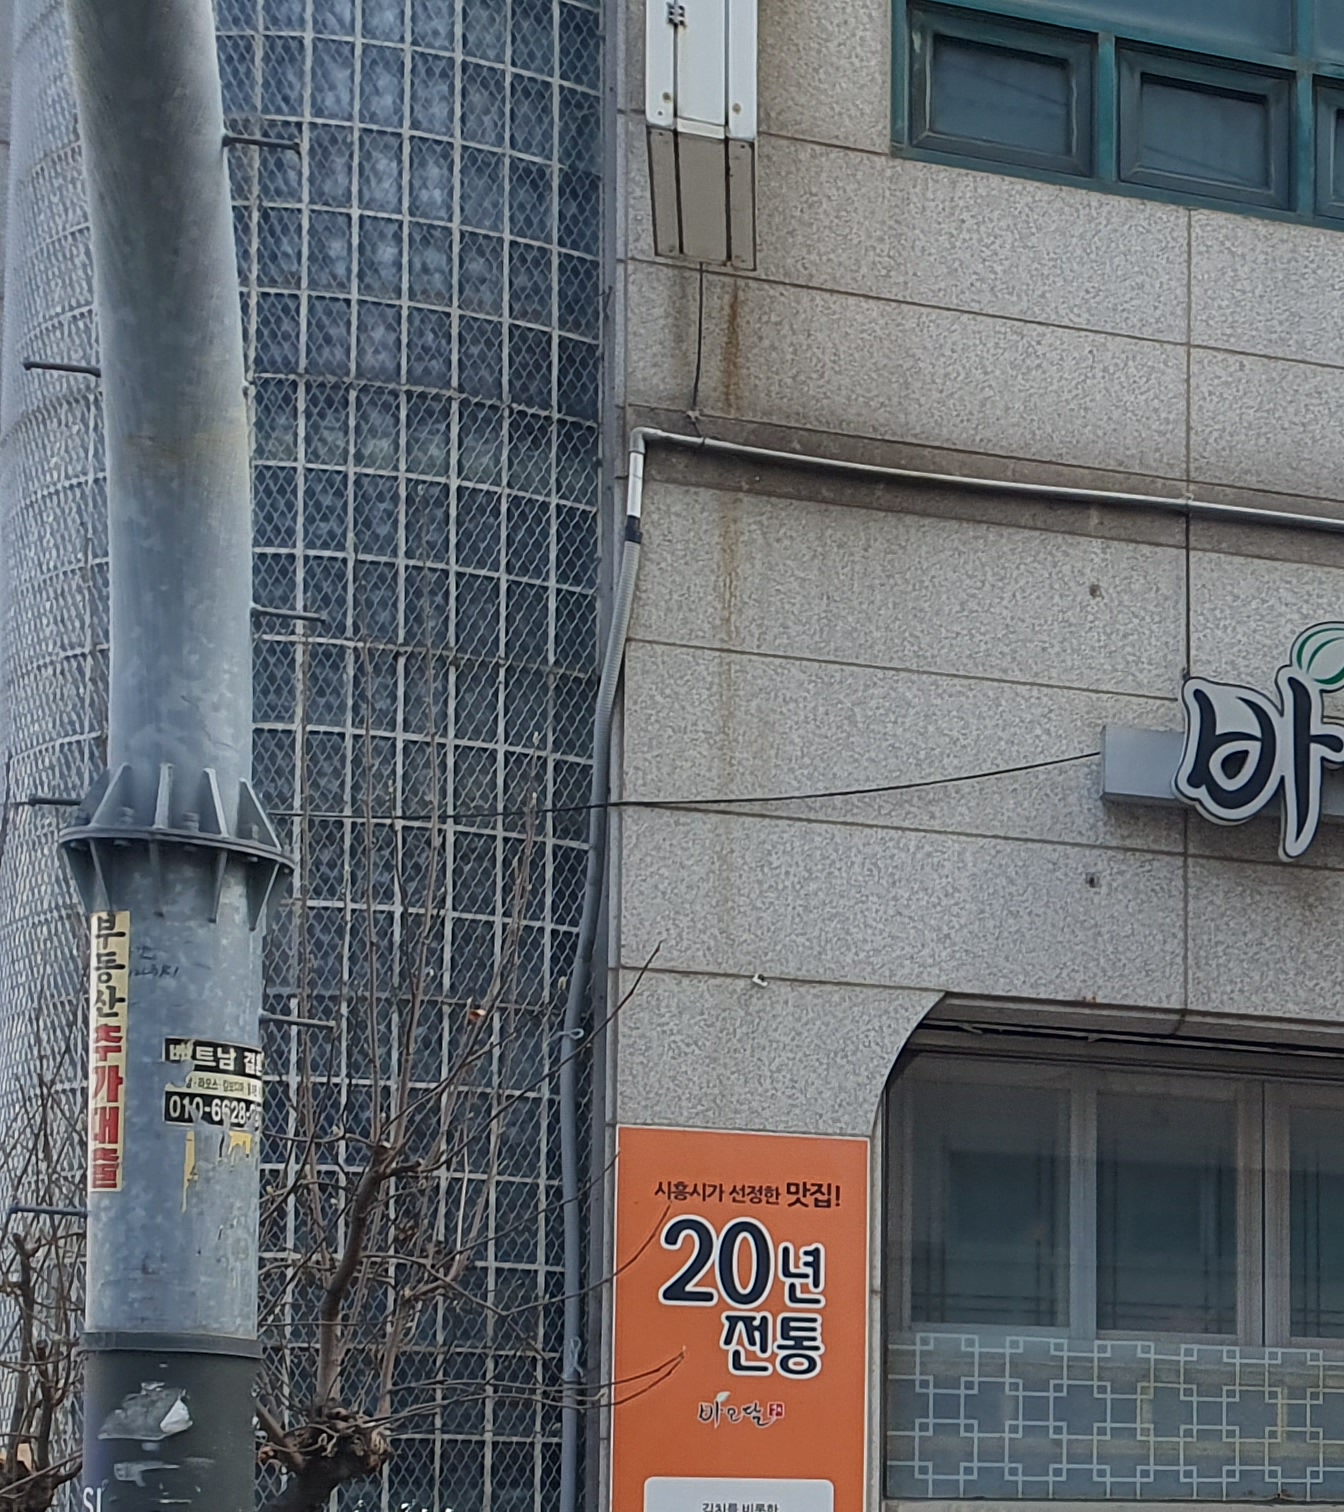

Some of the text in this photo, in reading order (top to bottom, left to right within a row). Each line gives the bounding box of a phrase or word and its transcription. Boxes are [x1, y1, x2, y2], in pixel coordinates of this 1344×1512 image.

[92, 1024, 124, 1189] 추가대출
[654, 1180, 841, 1207] 시흥시가 선정한 맛집!
[660, 1214, 826, 1307] 20년
[719, 1311, 826, 1379] 전통
